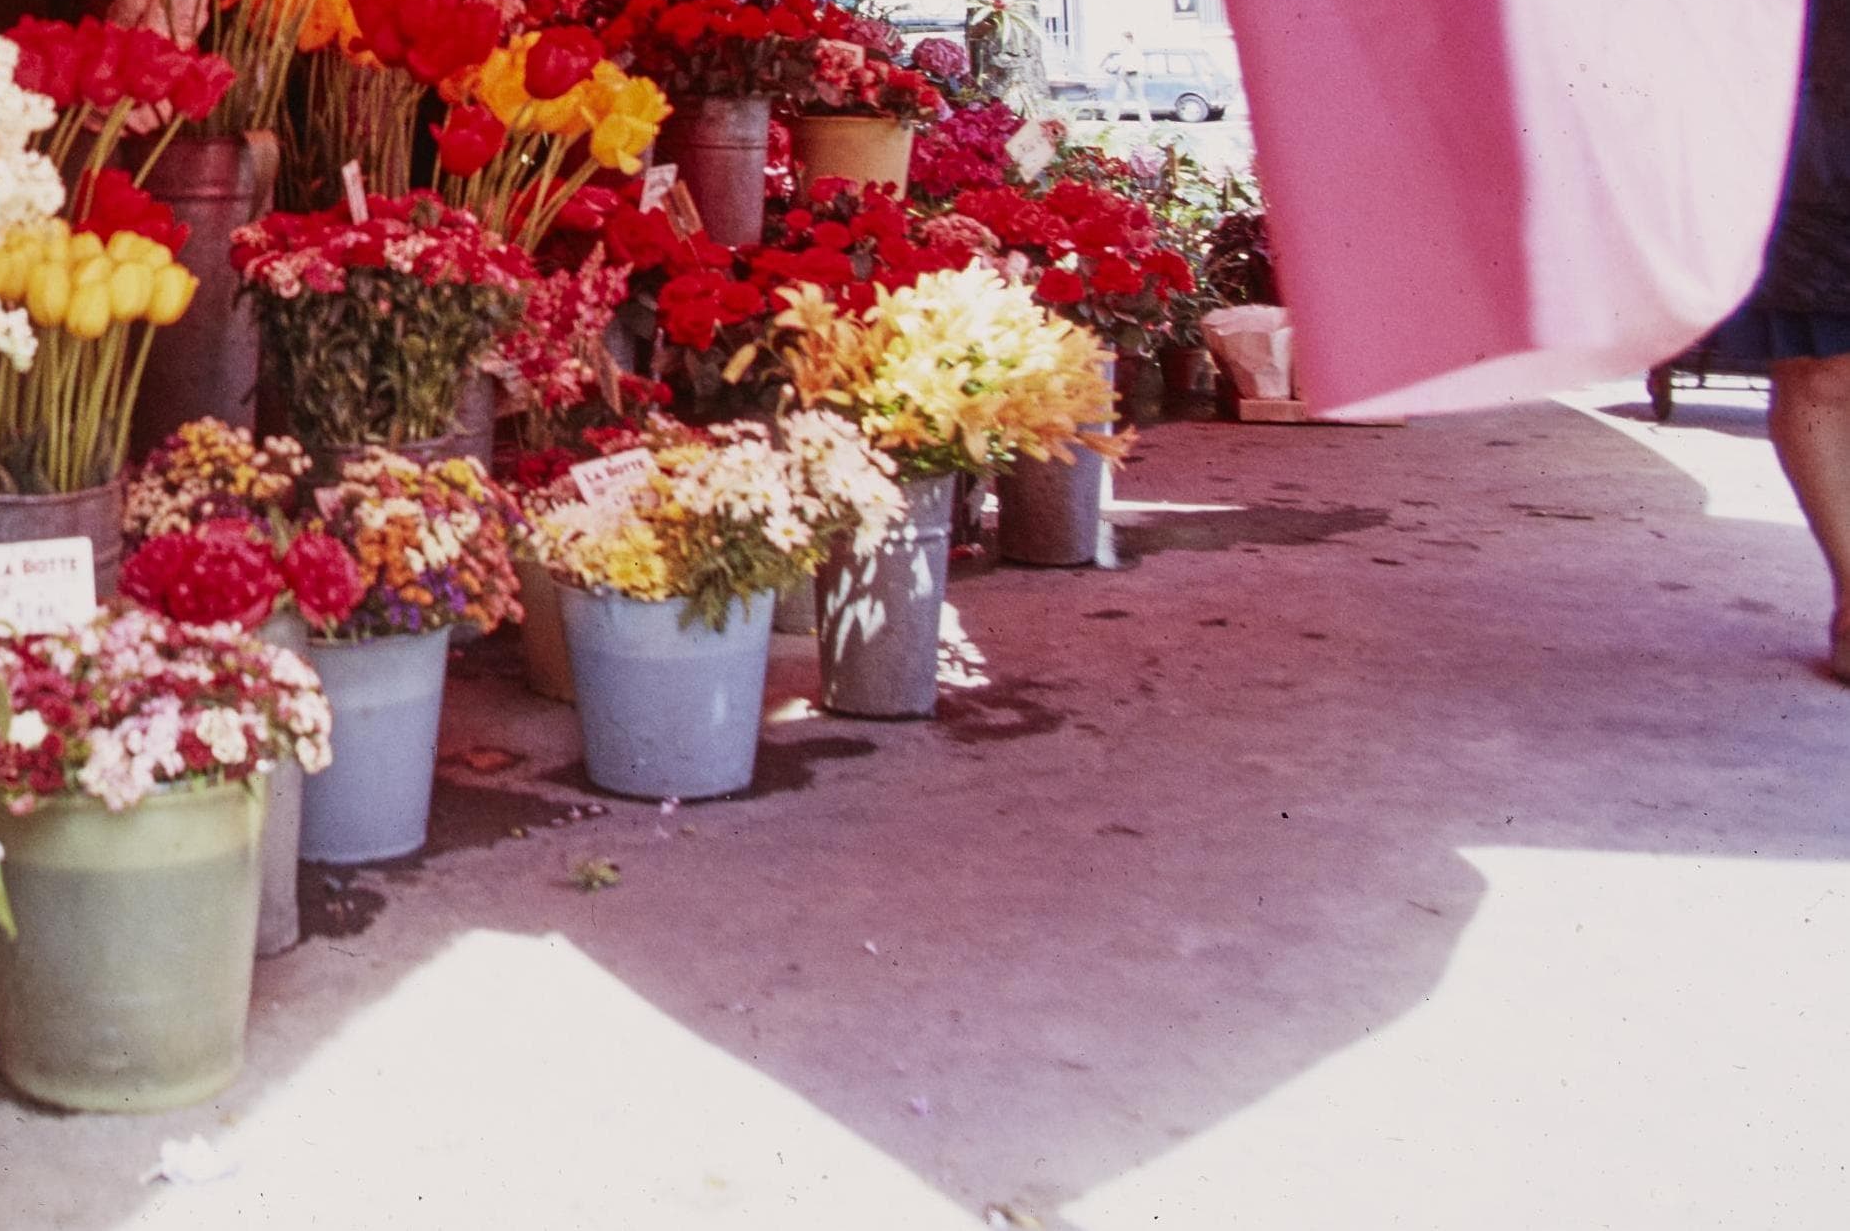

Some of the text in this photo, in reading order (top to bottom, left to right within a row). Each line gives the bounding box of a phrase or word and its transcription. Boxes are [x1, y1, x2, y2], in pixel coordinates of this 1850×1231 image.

[582, 458, 646, 483] LA BOTTE
[21, 557, 78, 576] BOTTE
